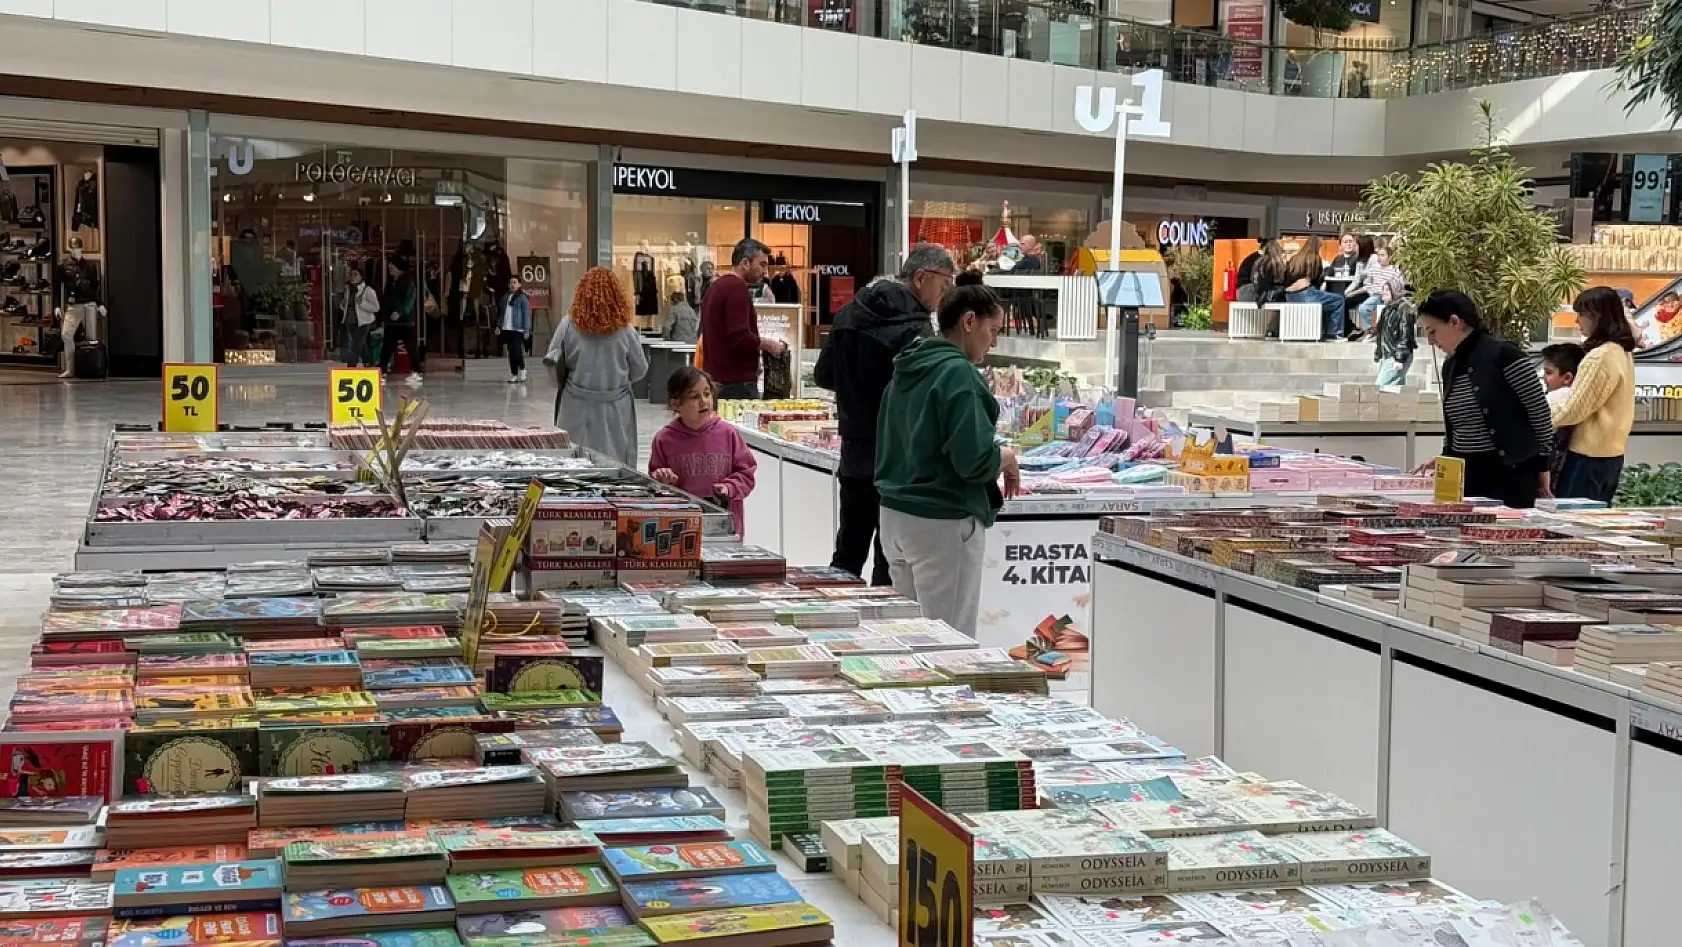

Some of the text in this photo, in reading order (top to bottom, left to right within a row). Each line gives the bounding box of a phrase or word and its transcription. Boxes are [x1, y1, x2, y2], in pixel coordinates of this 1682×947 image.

[295, 161, 420, 188] POLOGARAGE
[613, 166, 677, 190] IPEKYOL
[775, 203, 821, 222] IPEKYOL
[522, 264, 546, 283] 60
[171, 375, 210, 401] 50
[337, 378, 374, 403] 50
[183, 405, 198, 416] TL
[348, 406, 363, 418] TL
[1101, 501, 1139, 511] SARAY
[1005, 543, 1088, 561] ERASTA
[1002, 561, 1091, 585] 4. KİTA
[973, 860, 1006, 877] SSEİA
[1081, 855, 1146, 871] ODYSSEİA
[1347, 860, 1409, 875] ODYSSEİA
[1080, 874, 1145, 890] ODYSSEİA
[1216, 867, 1279, 883] ODYSSEİA
[973, 879, 1007, 895] SSEİA
